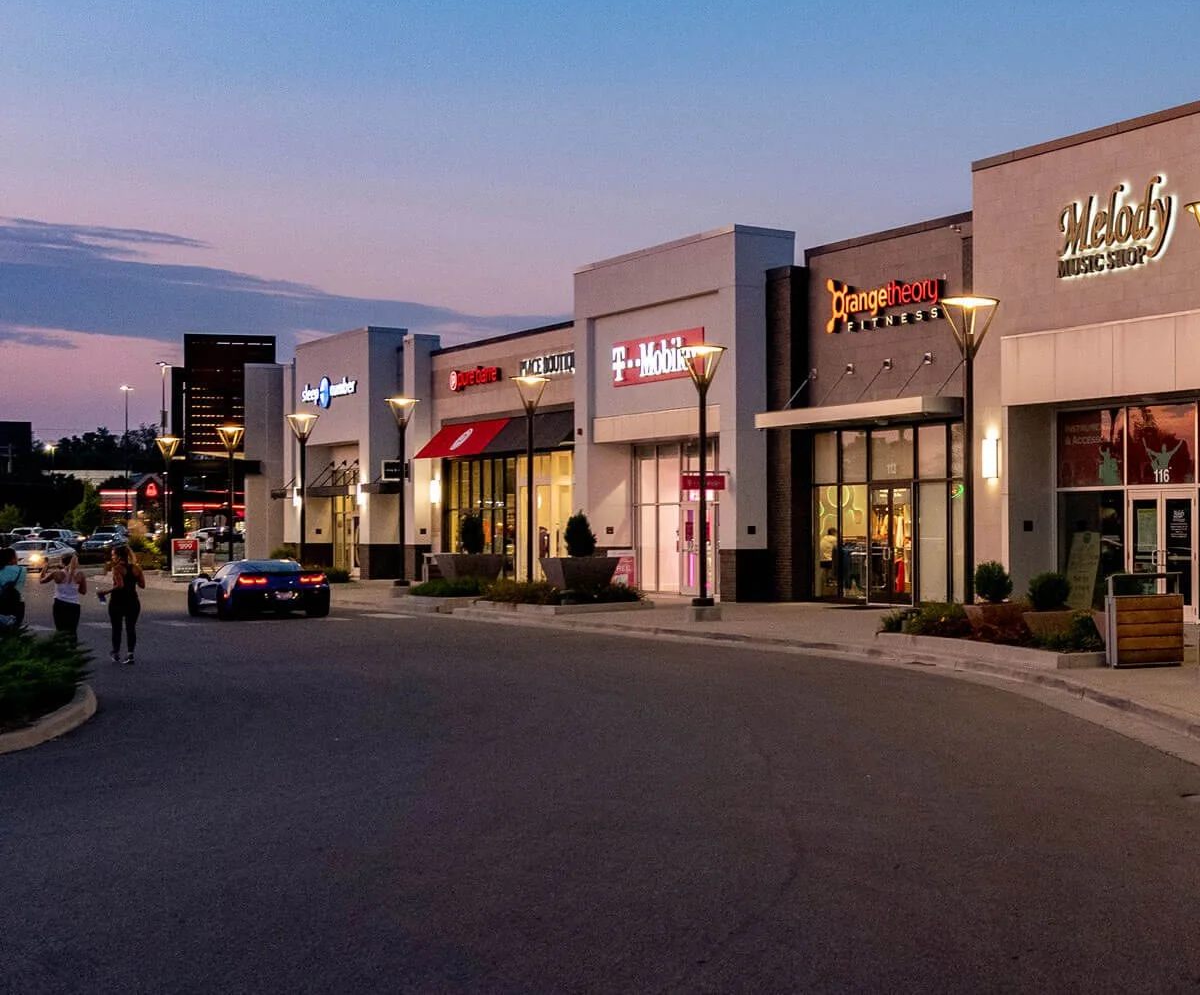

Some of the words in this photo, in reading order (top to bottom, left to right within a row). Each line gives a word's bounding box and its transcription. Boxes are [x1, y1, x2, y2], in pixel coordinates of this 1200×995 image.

[1056, 174, 1172, 258] Melody
[1057, 254, 1105, 279] MUSIC
[1106, 245, 1147, 269] SHOP
[847, 307, 940, 333] FITNESS
[457, 372, 475, 390] pure
[475, 366, 498, 384] barre
[301, 384, 321, 405] sleep
[1154, 468, 1170, 483] 116
